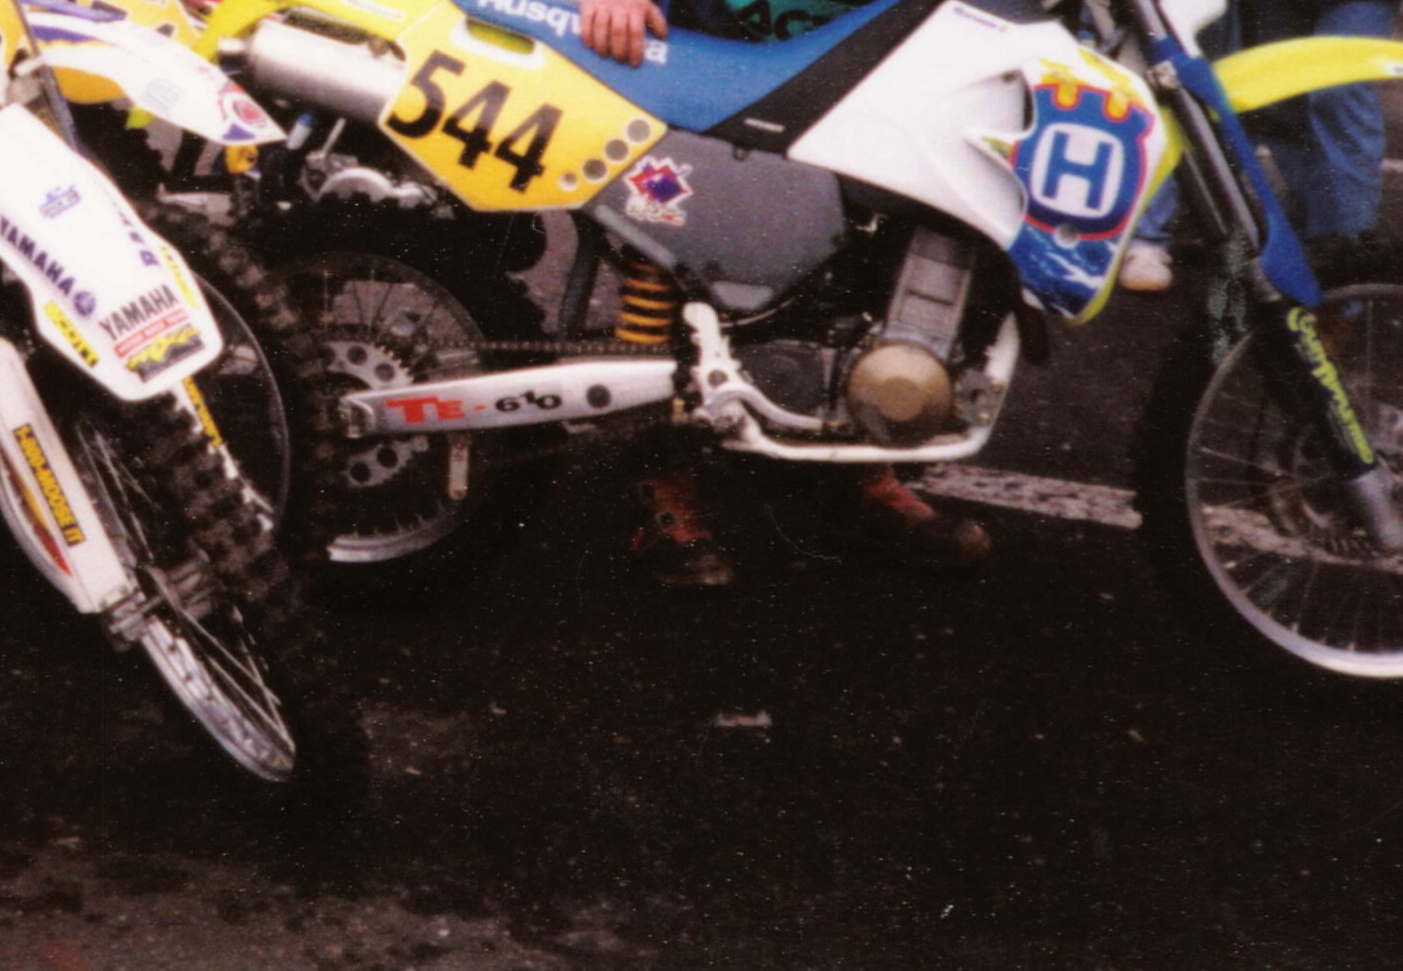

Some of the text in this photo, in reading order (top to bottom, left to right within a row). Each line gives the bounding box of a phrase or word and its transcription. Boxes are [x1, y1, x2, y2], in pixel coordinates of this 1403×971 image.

[384, 49, 564, 195] 544
[0, 214, 76, 297] YAMAHA
[99, 284, 180, 342] YAMAHA
